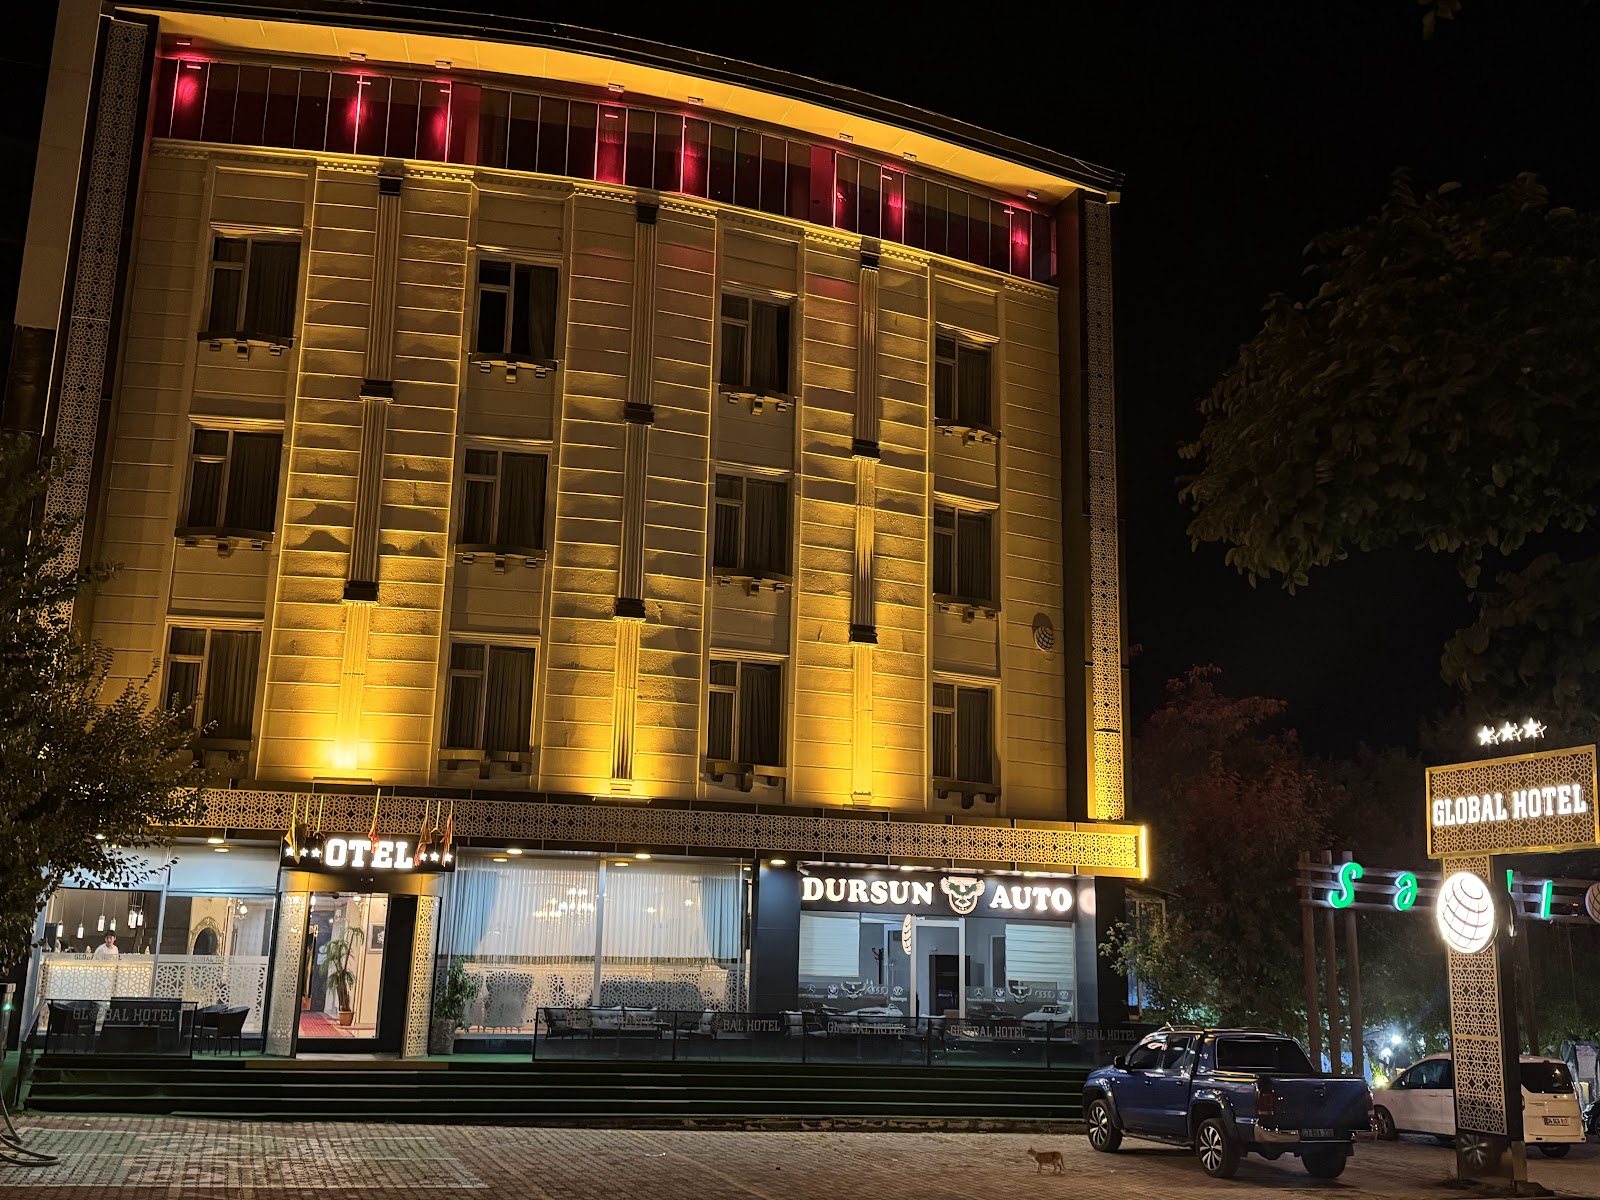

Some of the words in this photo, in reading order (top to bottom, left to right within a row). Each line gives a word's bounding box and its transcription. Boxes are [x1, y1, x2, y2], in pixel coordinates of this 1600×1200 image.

[1432, 792, 1507, 827] GLOBAL
[1512, 783, 1587, 819] HOTEL
[324, 838, 414, 869] OTEL
[802, 877, 935, 905] DURSUN
[989, 884, 1073, 912] AUTO
[133, 1008, 175, 1022] HOTEL
[747, 1019, 781, 1032] HOTEL
[995, 1025, 1026, 1039] HOTEL
[1107, 1029, 1137, 1041] HOTEL
